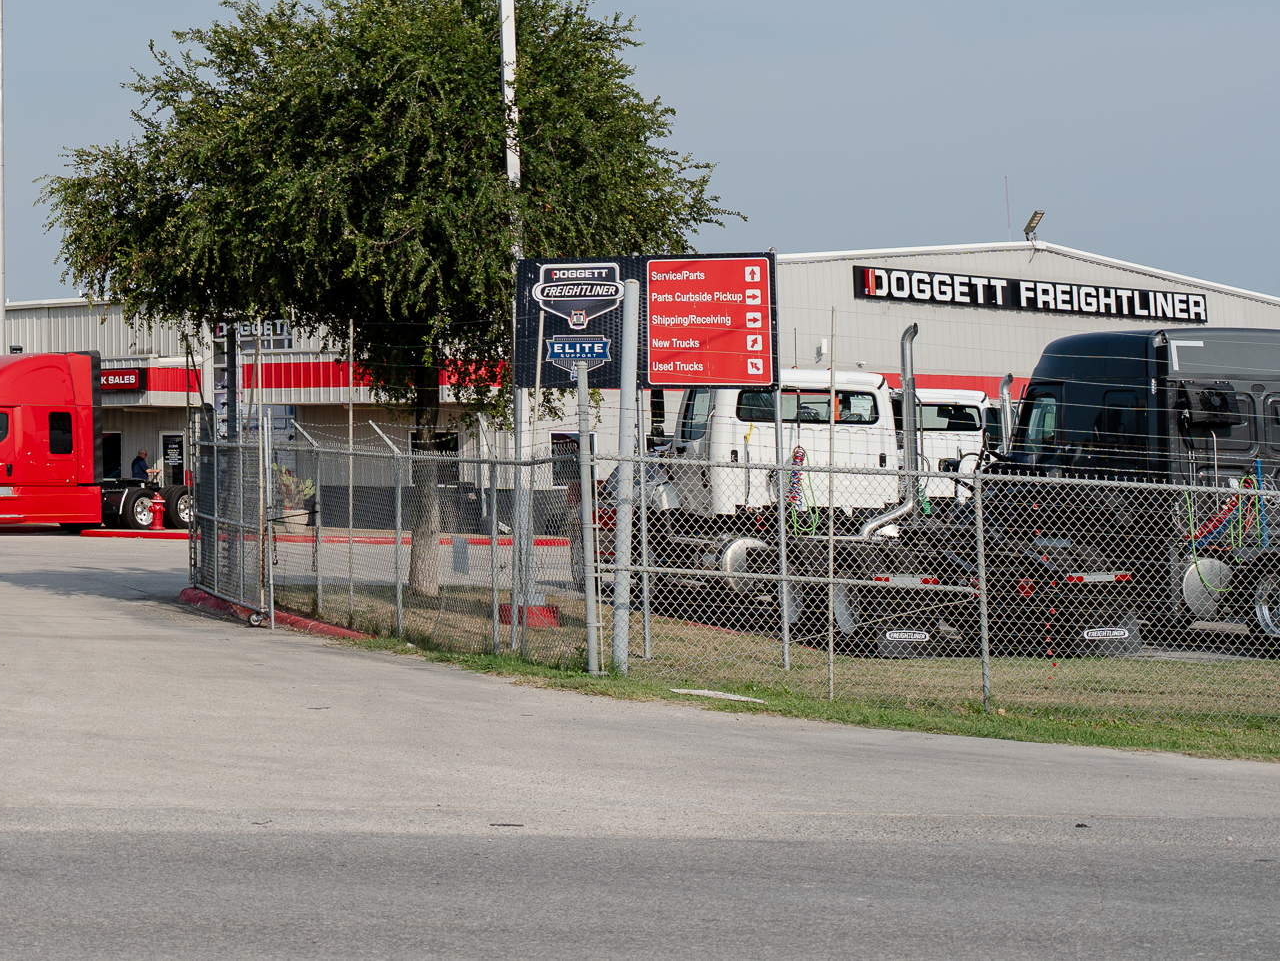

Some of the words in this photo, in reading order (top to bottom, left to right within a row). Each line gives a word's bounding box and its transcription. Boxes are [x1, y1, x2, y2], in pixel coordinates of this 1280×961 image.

[552, 270, 608, 279] DOGGETT
[651, 271, 705, 280] Service/Parts
[544, 285, 616, 296] FREIGHTLINER
[864, 268, 1008, 305] DOGGETT
[1020, 281, 1207, 320] FREIGHTLINER
[651, 292, 673, 302] Parts
[675, 292, 712, 301] Curbside
[714, 291, 743, 303] Pickup
[651, 314, 731, 326] Shipping/Receiving
[553, 343, 604, 353] ELITE
[652, 339, 670, 348] New
[671, 338, 700, 348] Trucks
[652, 362, 673, 371] Used
[675, 362, 704, 371] Trucks
[108, 375, 136, 384] SALES
